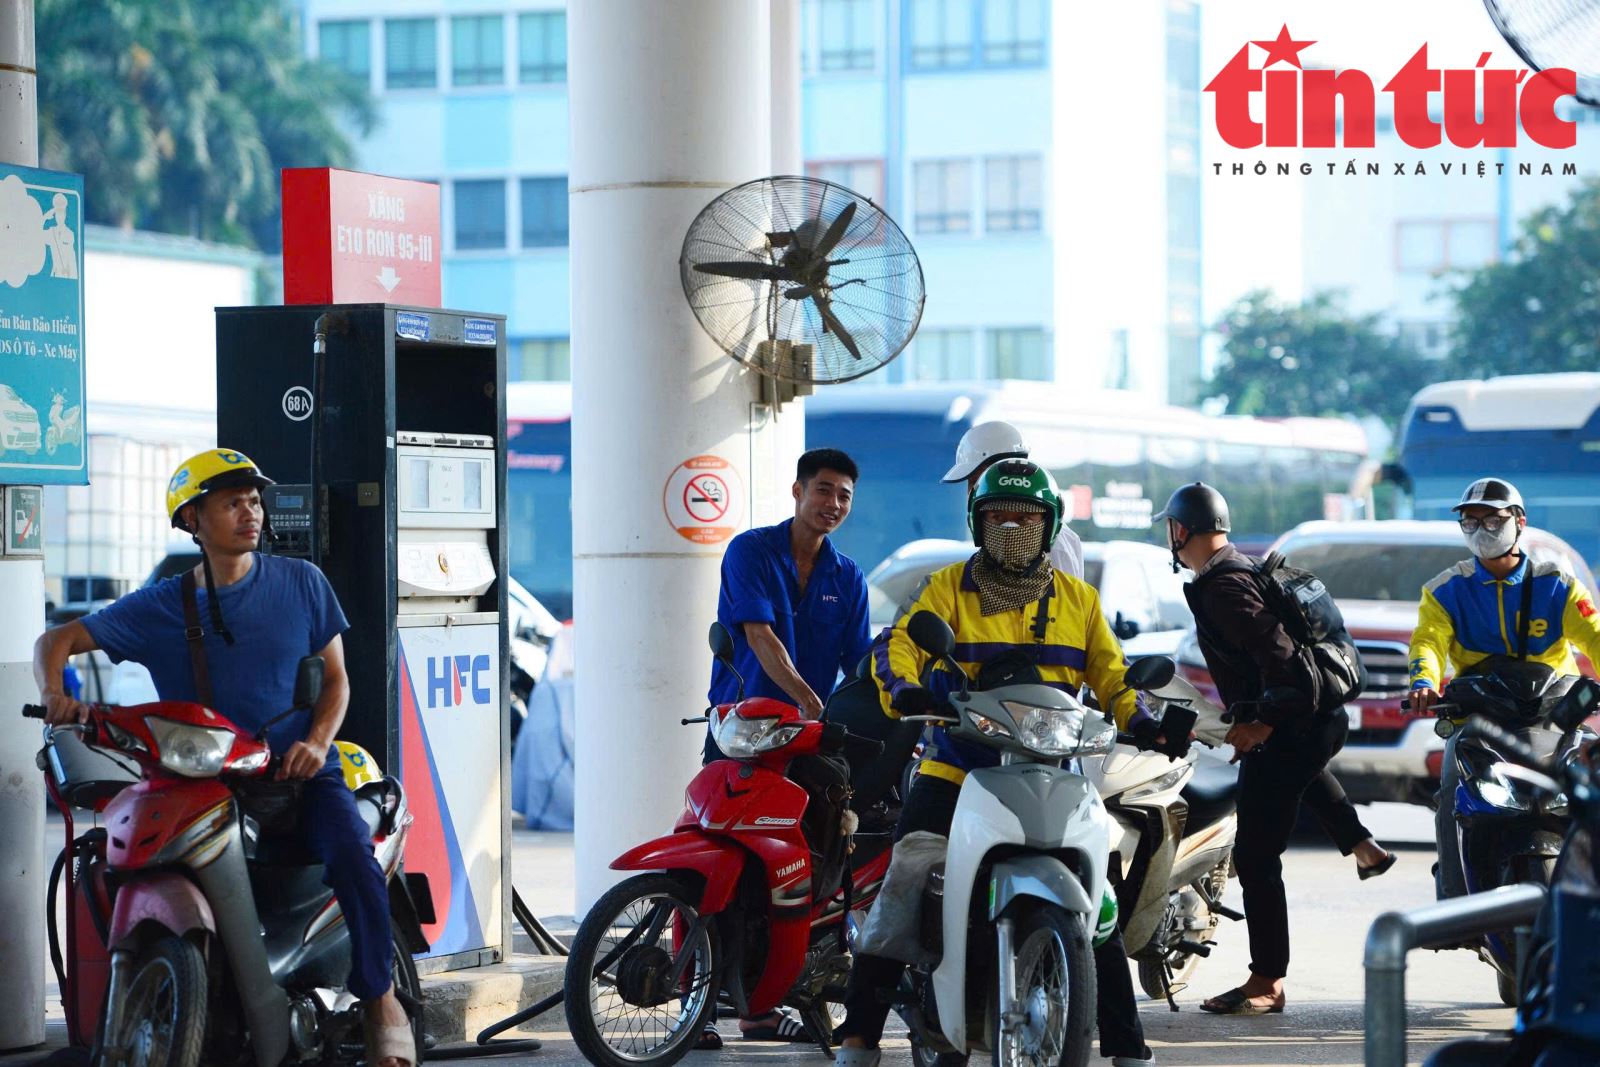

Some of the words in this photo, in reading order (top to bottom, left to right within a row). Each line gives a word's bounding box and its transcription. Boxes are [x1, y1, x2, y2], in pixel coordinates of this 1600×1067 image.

[367, 186, 405, 223] XĂNG
[337, 224, 363, 256] E10
[366, 228, 396, 258] RON
[0, 309, 11, 329] m
[12, 314, 32, 331] Bán
[32, 316, 51, 333] Bảo
[52, 315, 77, 335] Hiểm
[13, 336, 22, 355] Ô
[23, 340, 37, 356] Tô
[44, 343, 57, 358] Xe
[58, 344, 78, 362] Máy
[998, 476, 1032, 488] Grab
[427, 654, 491, 709] HFC
[776, 858, 806, 878] YAMAHA
